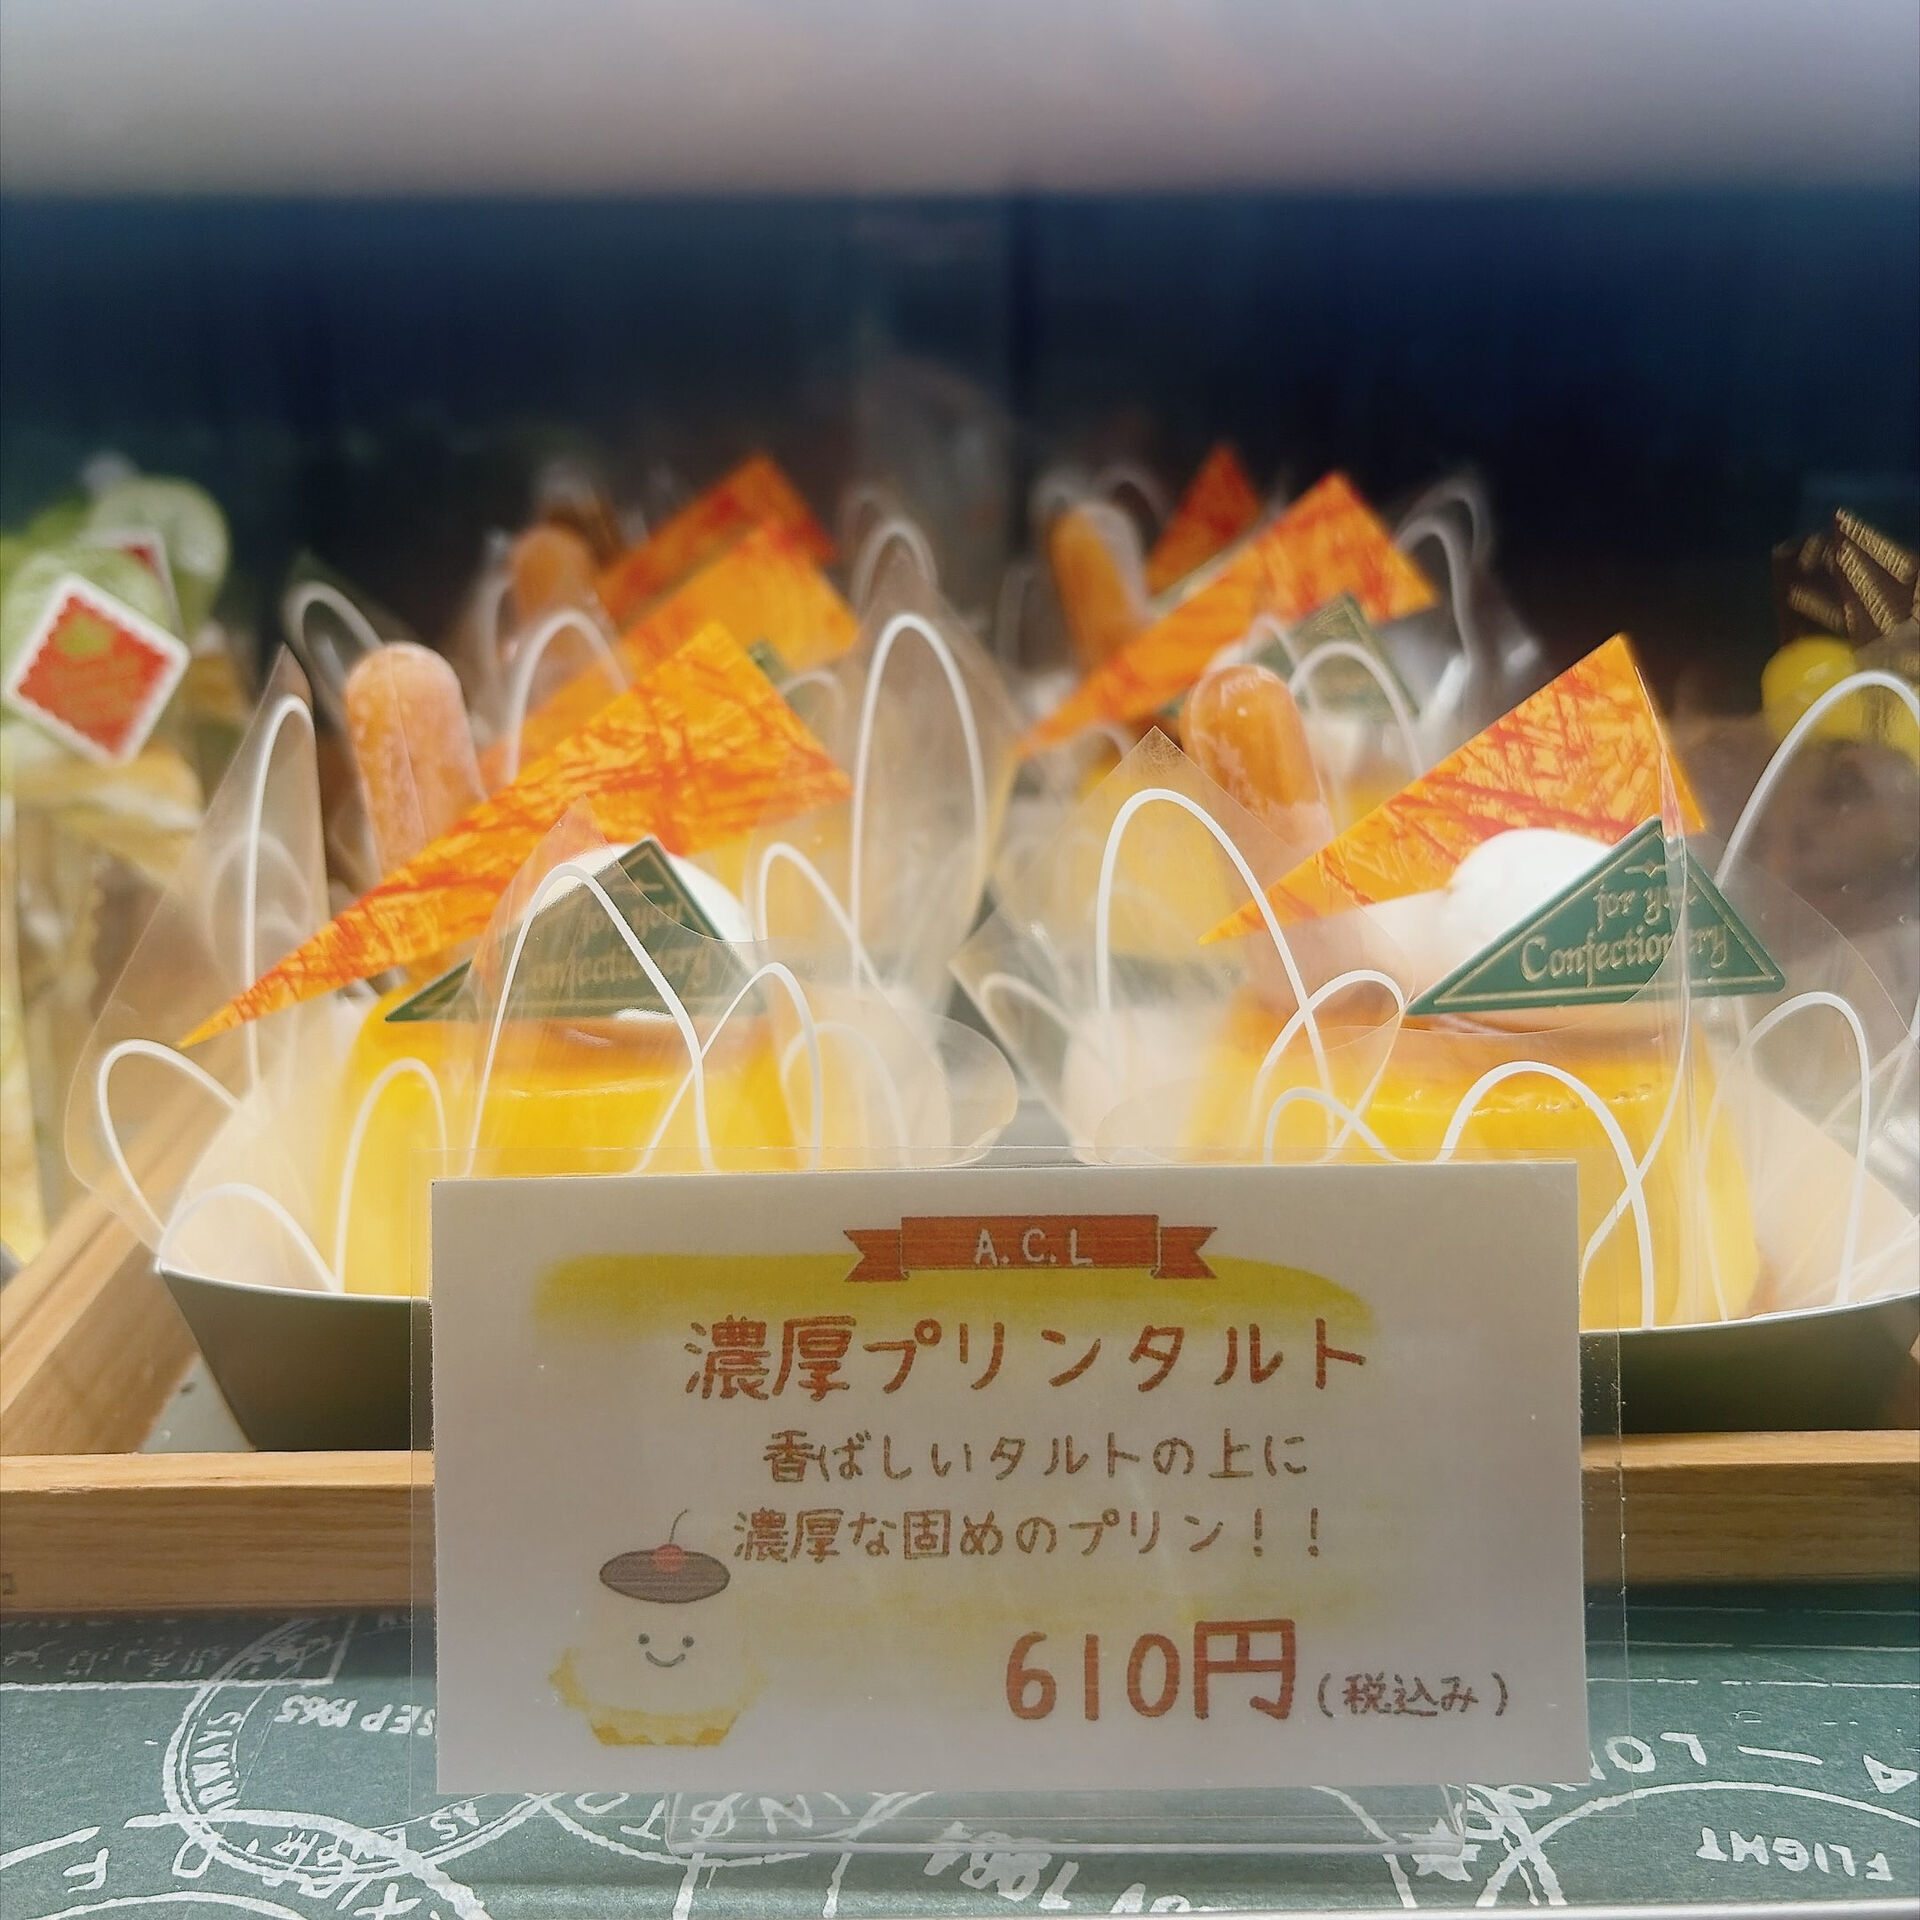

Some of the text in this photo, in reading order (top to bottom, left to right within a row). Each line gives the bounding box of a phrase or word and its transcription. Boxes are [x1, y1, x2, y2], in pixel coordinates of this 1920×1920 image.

[684, 1315, 1366, 1402] 濃厚プリンタルト
[763, 1428, 1308, 1483] 香ばしいタルトの上に
[1005, 1618, 1296, 1722] 610円
[275, 1694, 436, 1736] SEP 1965
[1696, 1826, 1893, 1881] FLIGHT
